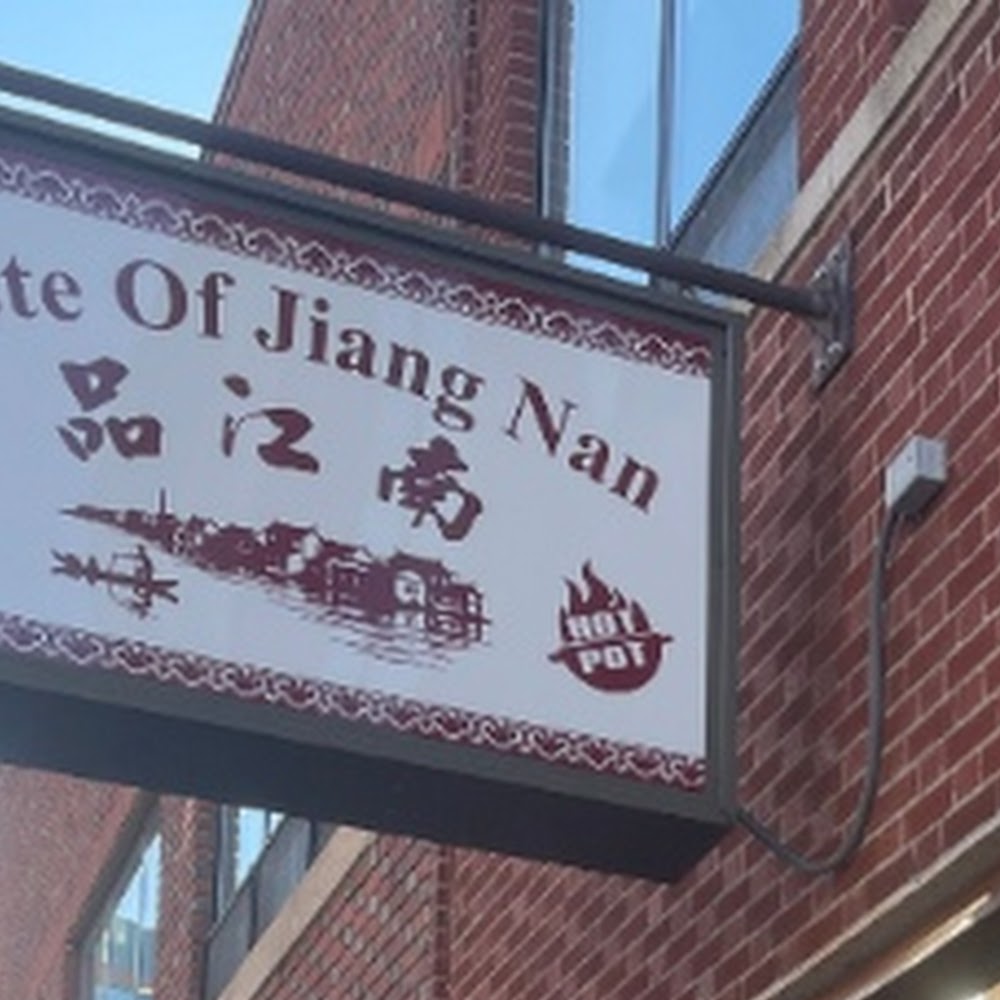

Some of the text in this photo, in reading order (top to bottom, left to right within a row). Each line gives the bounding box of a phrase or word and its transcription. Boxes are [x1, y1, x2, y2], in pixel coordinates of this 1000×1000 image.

[115, 258, 236, 339] Of
[254, 285, 484, 432] Jiang
[505, 378, 660, 513] Nan
[566, 609, 636, 639] HOT
[577, 641, 646, 674] POT
